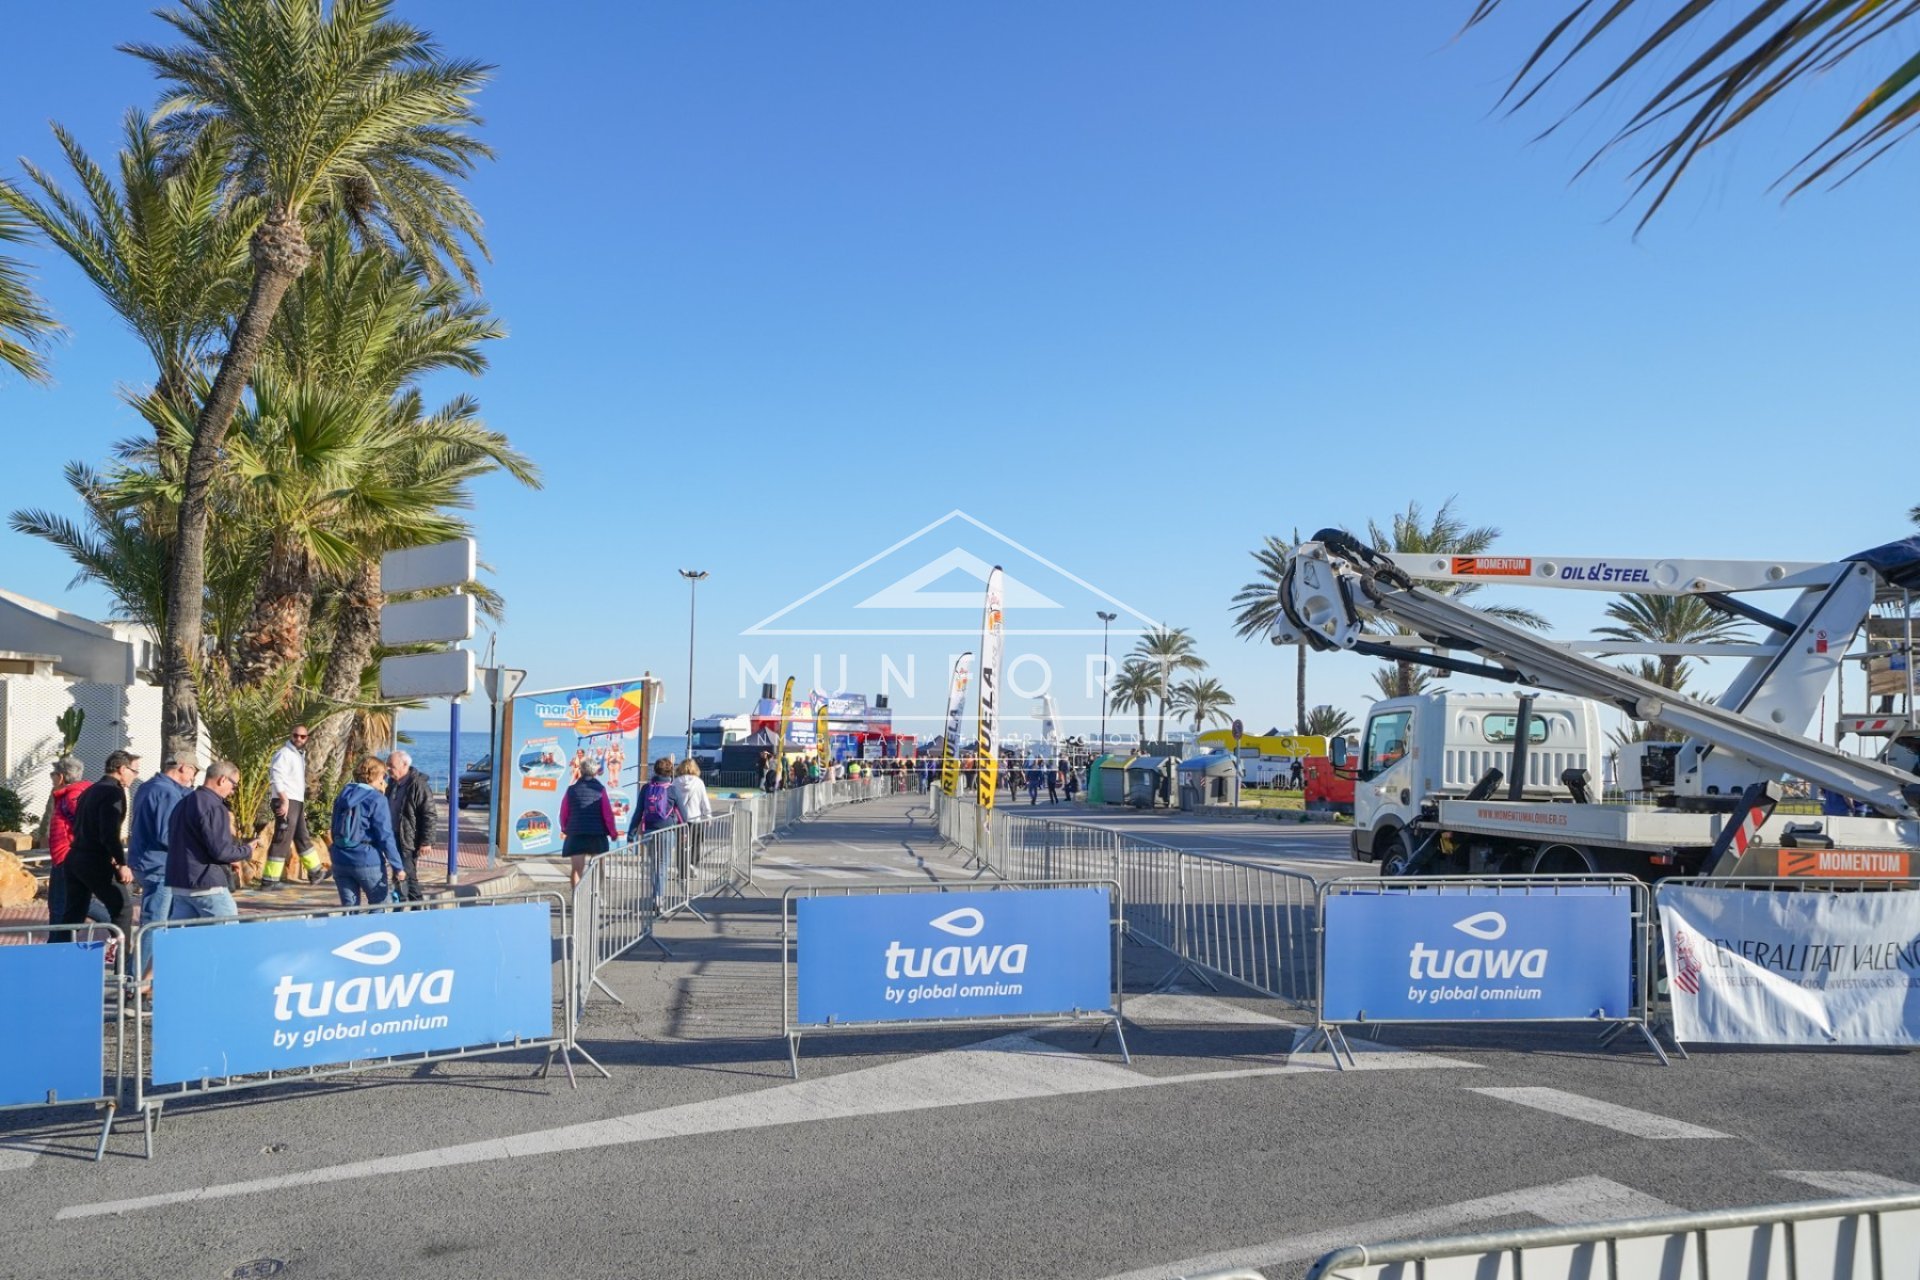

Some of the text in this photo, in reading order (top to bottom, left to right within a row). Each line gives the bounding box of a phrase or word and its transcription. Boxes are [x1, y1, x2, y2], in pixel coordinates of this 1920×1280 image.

[1476, 558, 1527, 571] MOMENTUM
[1820, 852, 1900, 872] MOMENTUM
[885, 941, 1028, 979] tuawa
[1409, 942, 1548, 980] tuawa
[273, 969, 455, 1021] tuawa
[885, 982, 1022, 1004] by global omnium
[1408, 985, 1541, 1004] by global omnium
[273, 1014, 449, 1050] by global omnium
